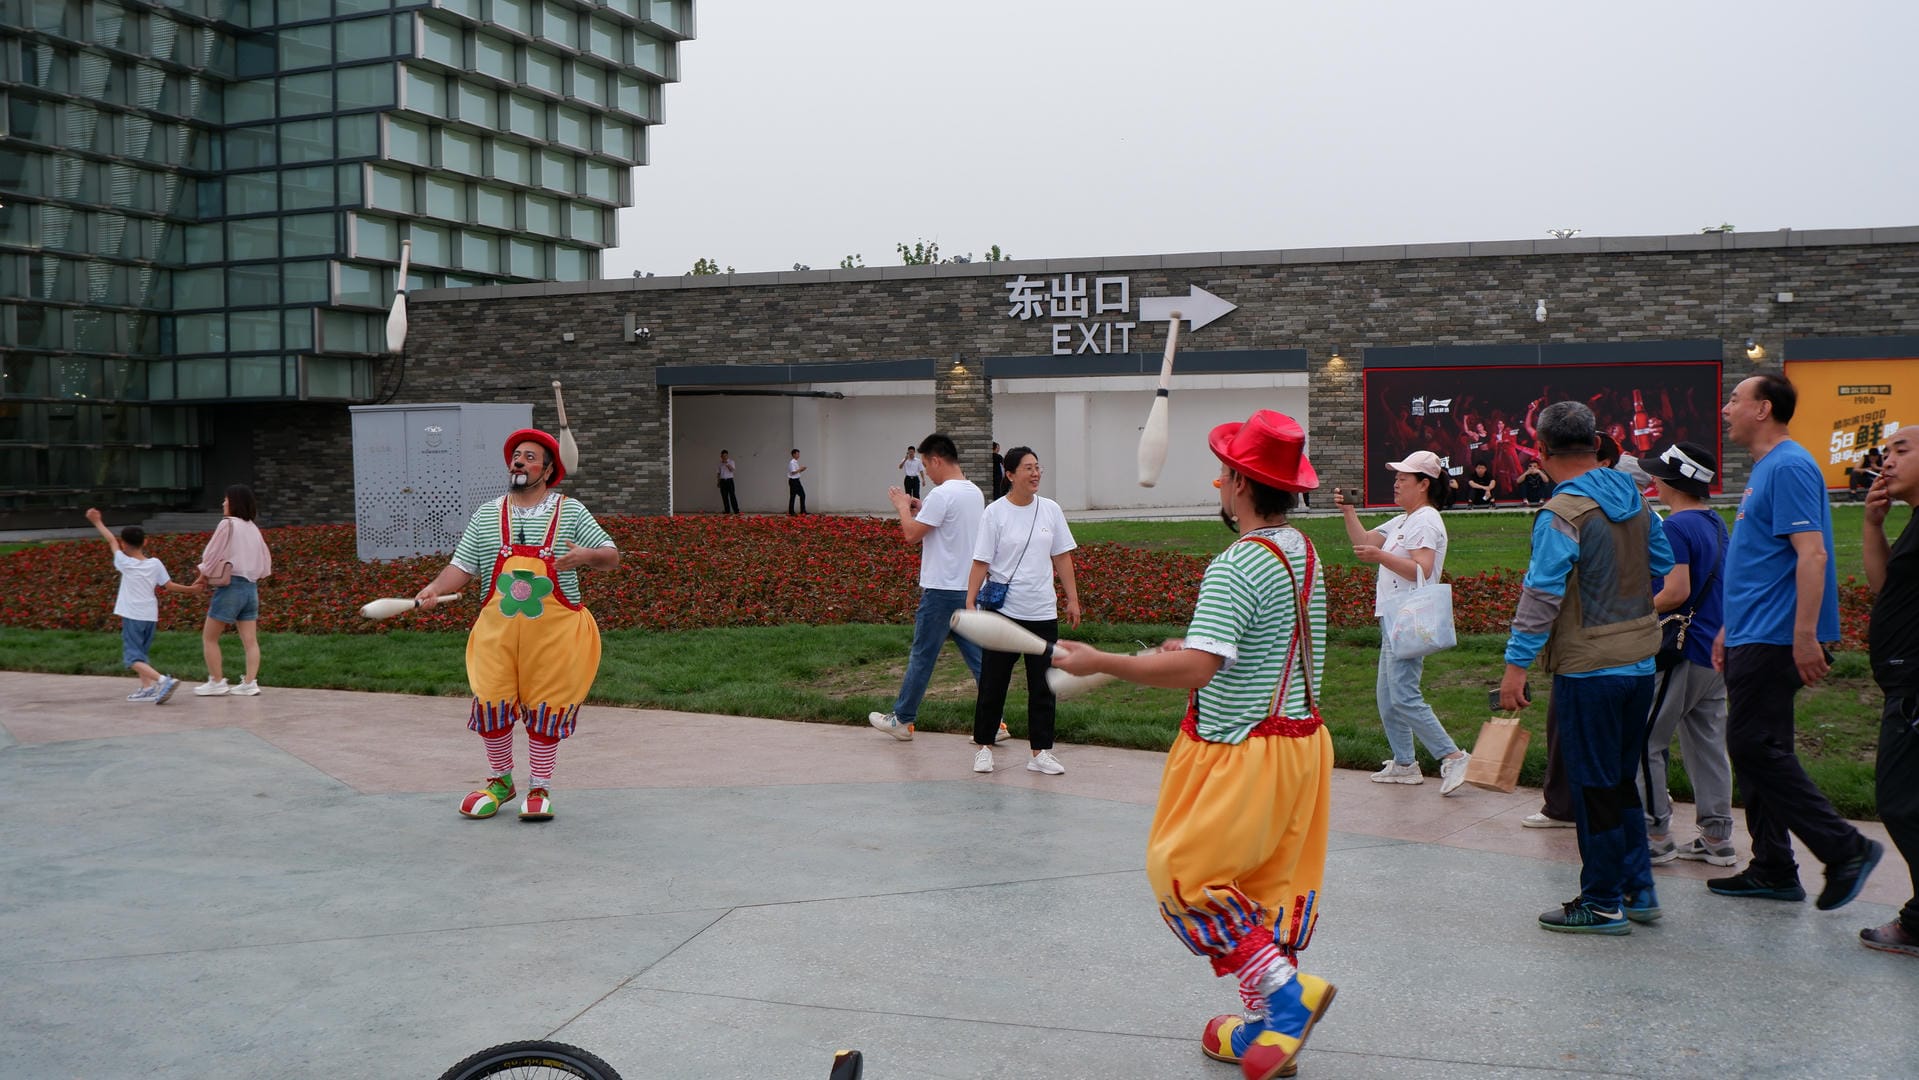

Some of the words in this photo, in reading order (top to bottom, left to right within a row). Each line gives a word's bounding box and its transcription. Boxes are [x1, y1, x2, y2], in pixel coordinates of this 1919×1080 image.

[1005, 273, 1130, 321] 东出口
[1052, 322, 1136, 355] EXIT
